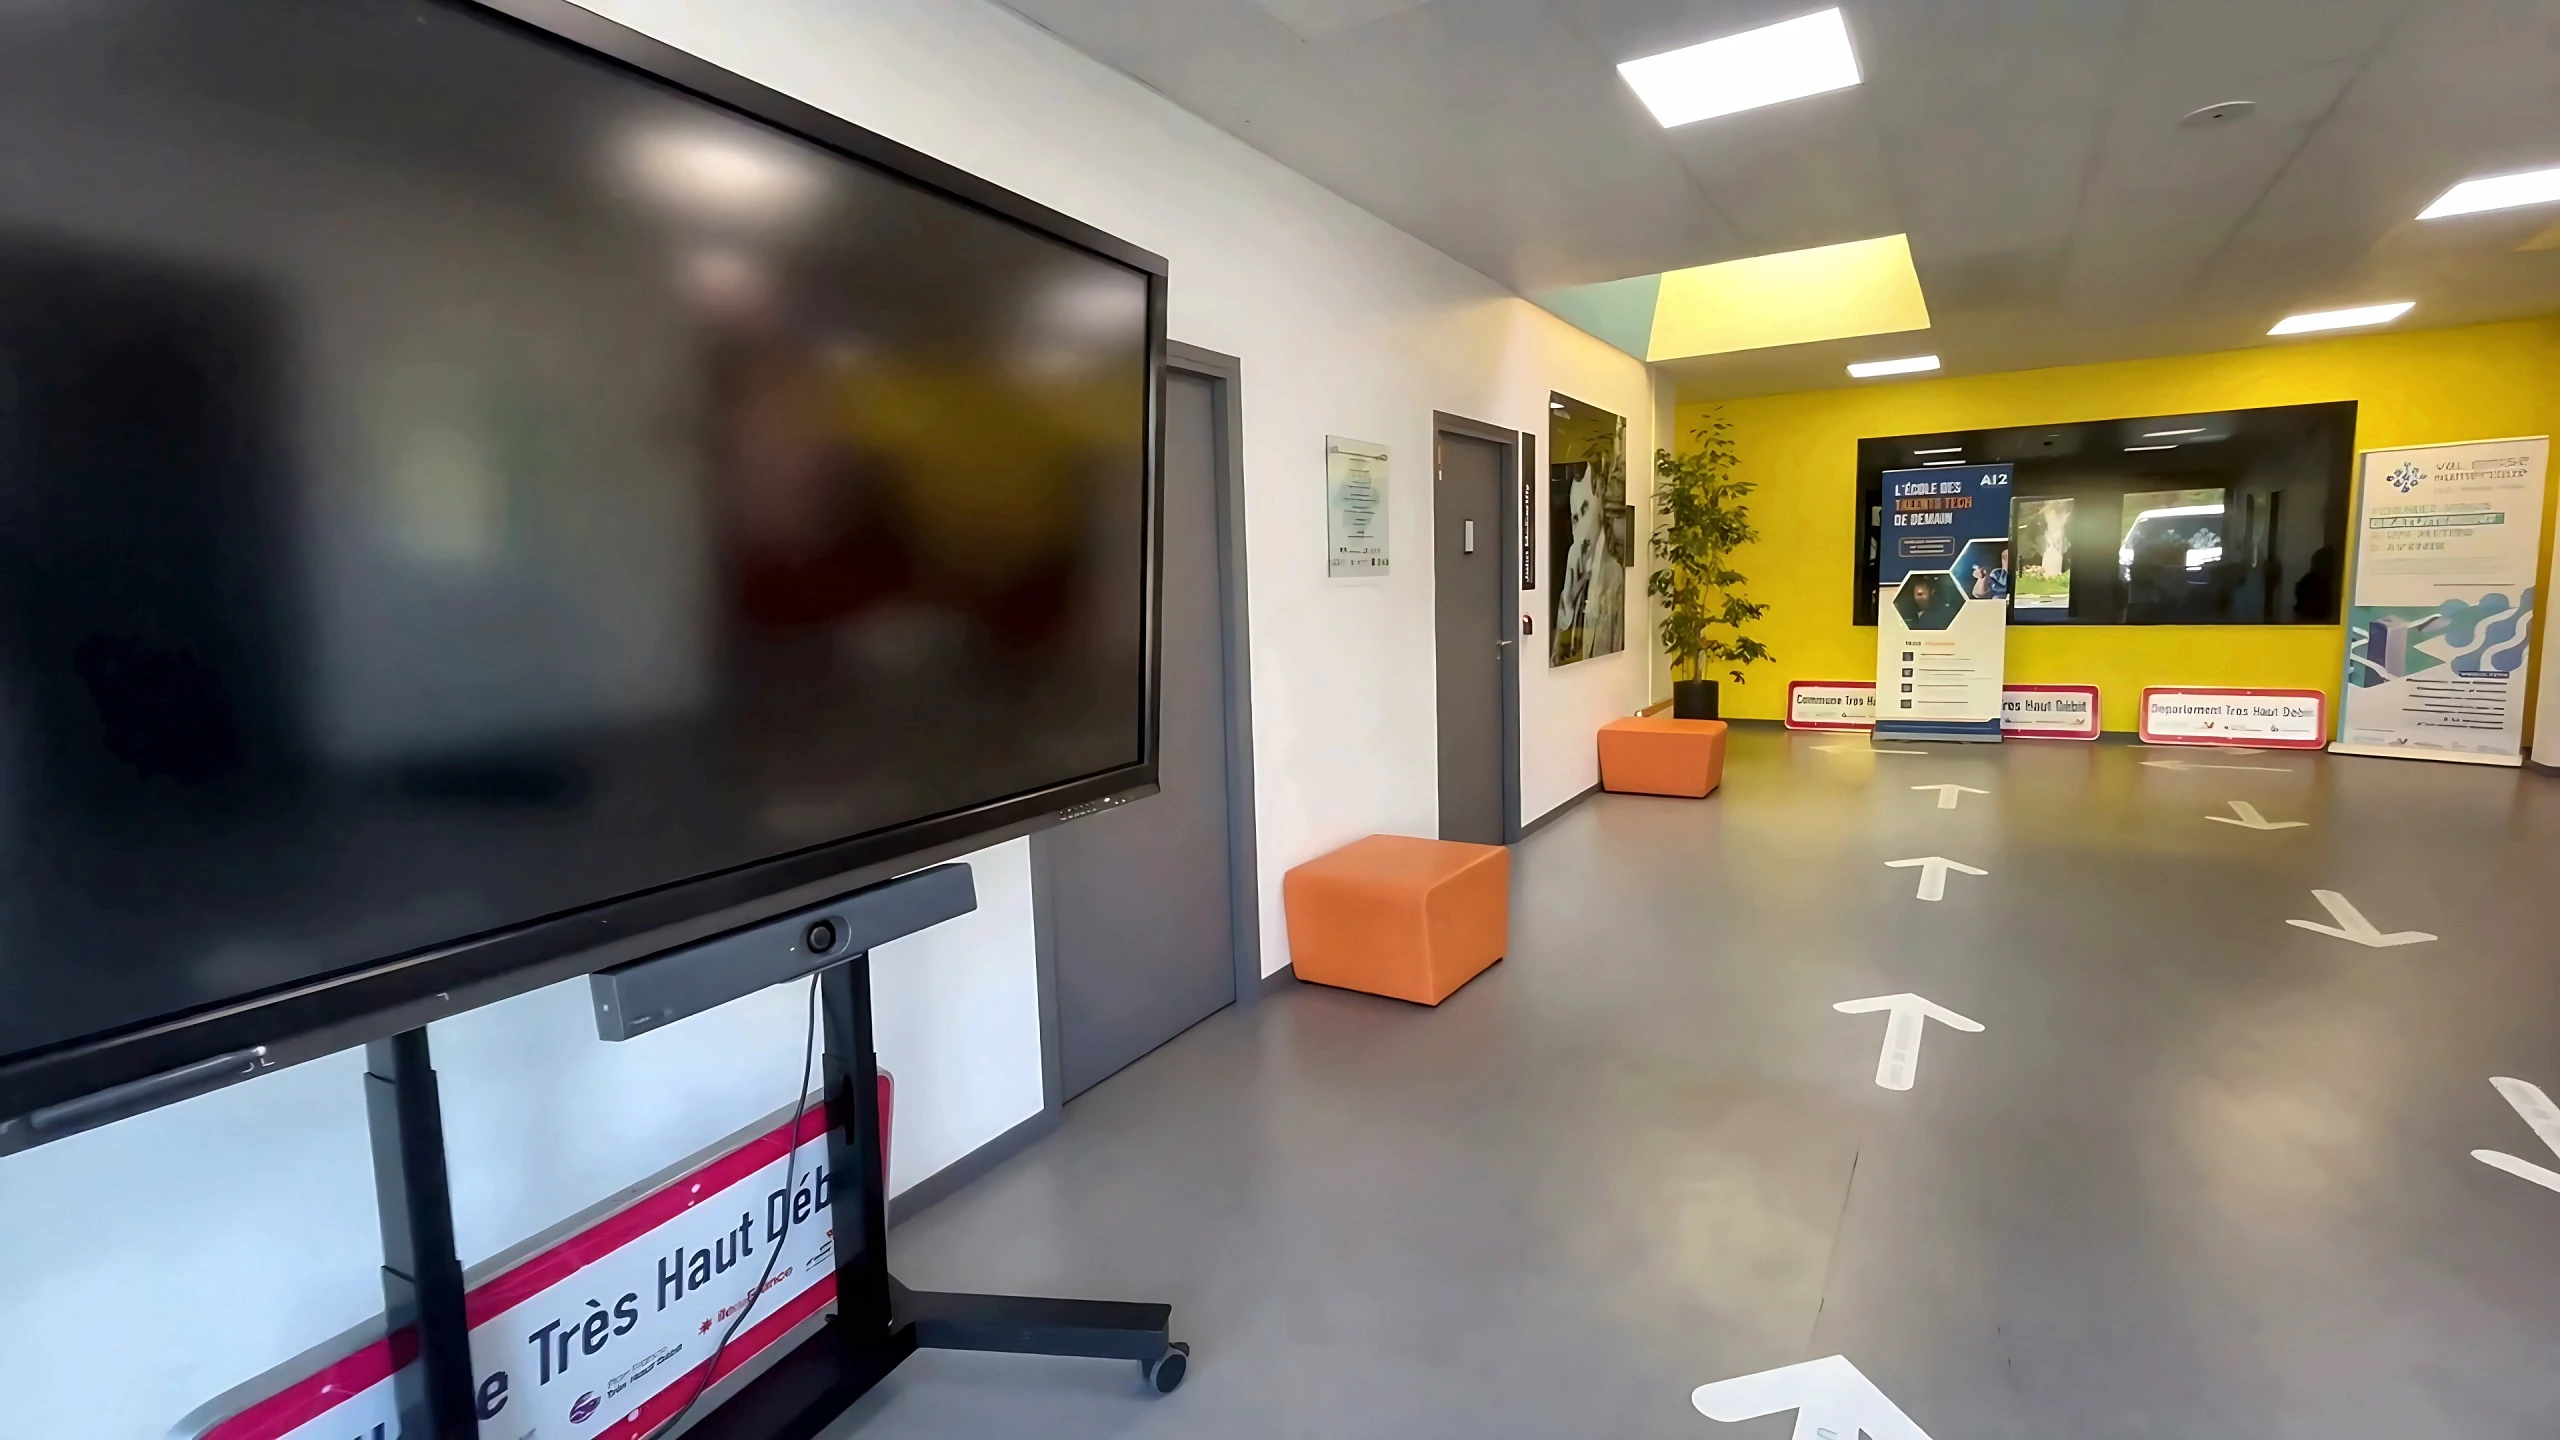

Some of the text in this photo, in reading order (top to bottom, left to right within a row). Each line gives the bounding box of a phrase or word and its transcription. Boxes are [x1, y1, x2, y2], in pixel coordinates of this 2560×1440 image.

[1894, 514, 1908, 526] DE
[529, 1292, 638, 1387] Très
[657, 1212, 754, 1312] Haut
[767, 1165, 832, 1244] Déb
